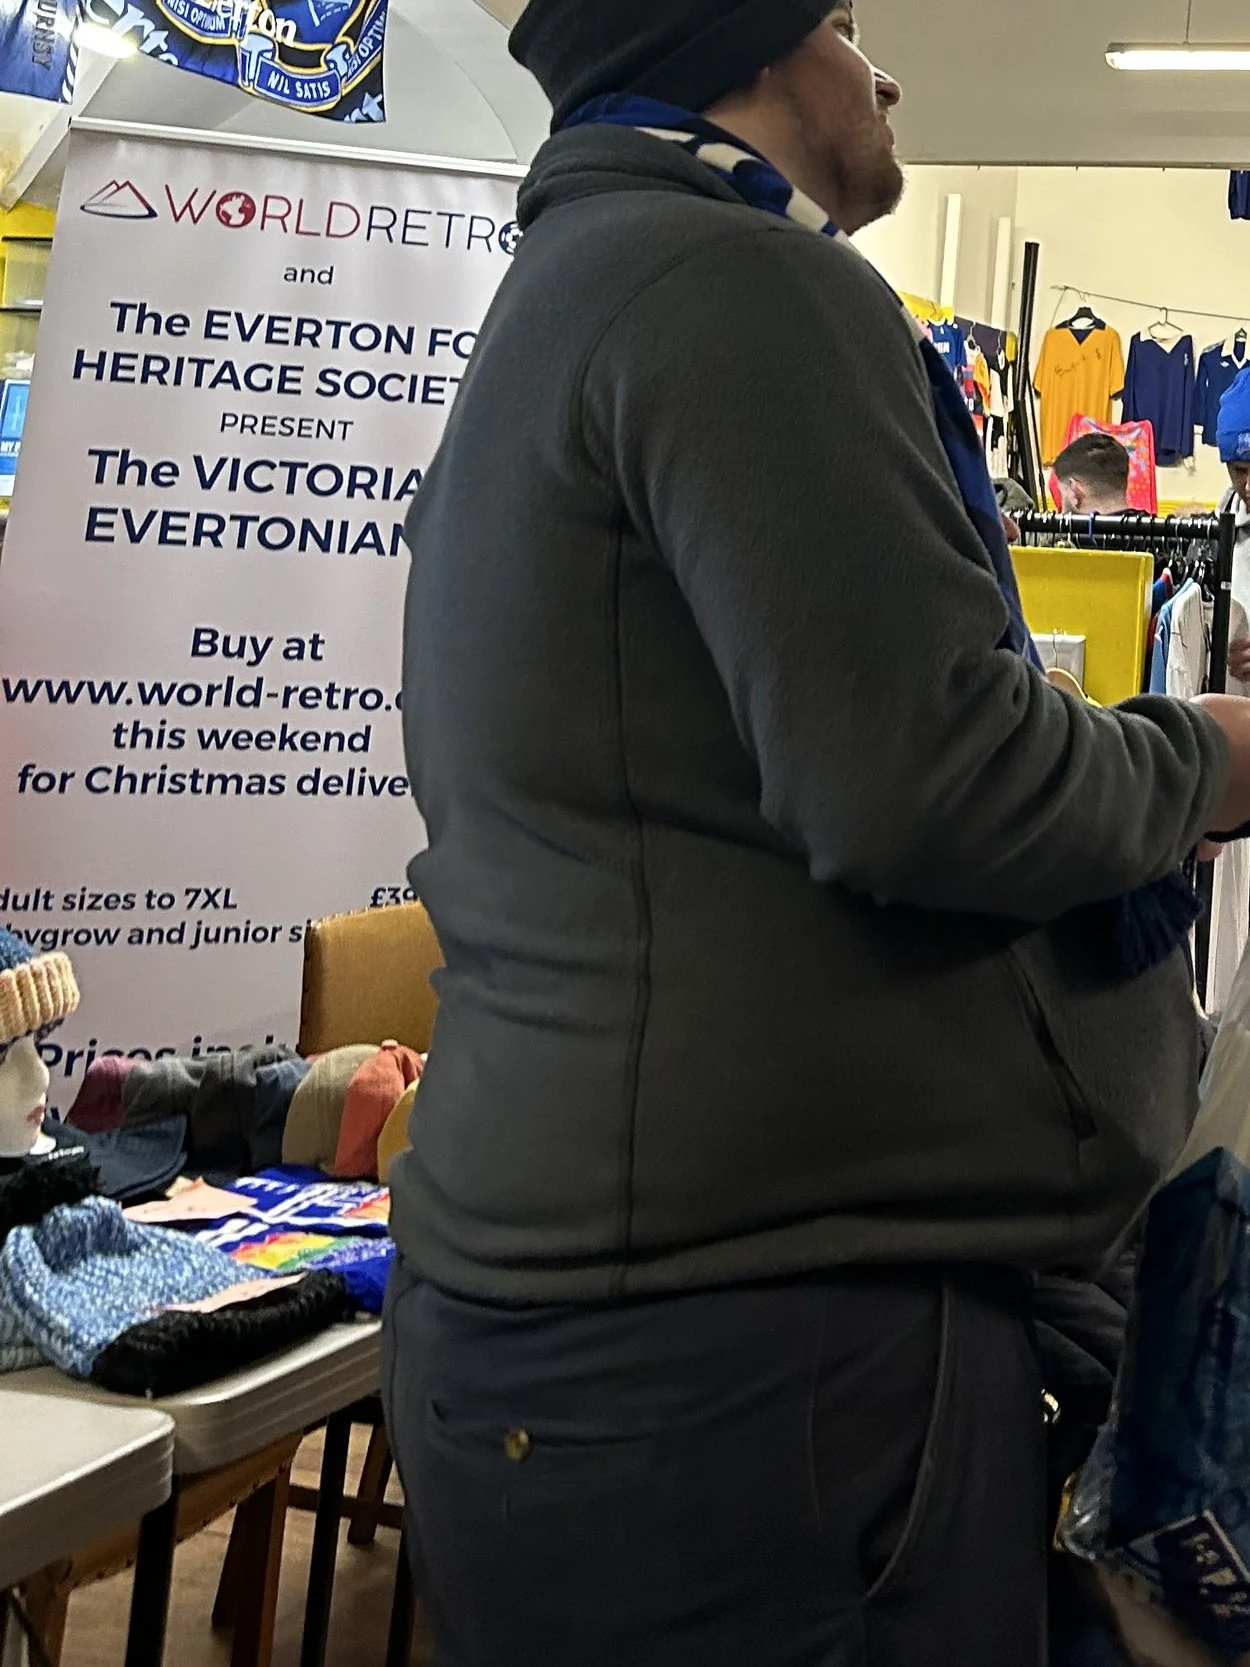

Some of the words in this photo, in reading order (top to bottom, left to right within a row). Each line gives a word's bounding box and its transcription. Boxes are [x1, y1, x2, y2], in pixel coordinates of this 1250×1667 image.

[267, 70, 291, 94] NIL
[295, 80, 331, 99] SATIS
[283, 264, 334, 286] and
[110, 301, 190, 338] The
[203, 309, 415, 358] EVERTON
[71, 348, 304, 396] HERITAGE
[219, 412, 354, 442] PRESENT
[87, 448, 180, 489] The
[191, 626, 273, 667] Buy
[282, 633, 325, 662] at
[112, 719, 186, 751] this
[197, 722, 372, 754] weekend
[17, 763, 75, 797] for
[84, 764, 286, 797] Christmas
[62, 886, 136, 911] sizes
[145, 888, 175, 911] to
[184, 887, 238, 911] 7XL
[127, 920, 184, 946] and
[189, 918, 283, 950] junior
